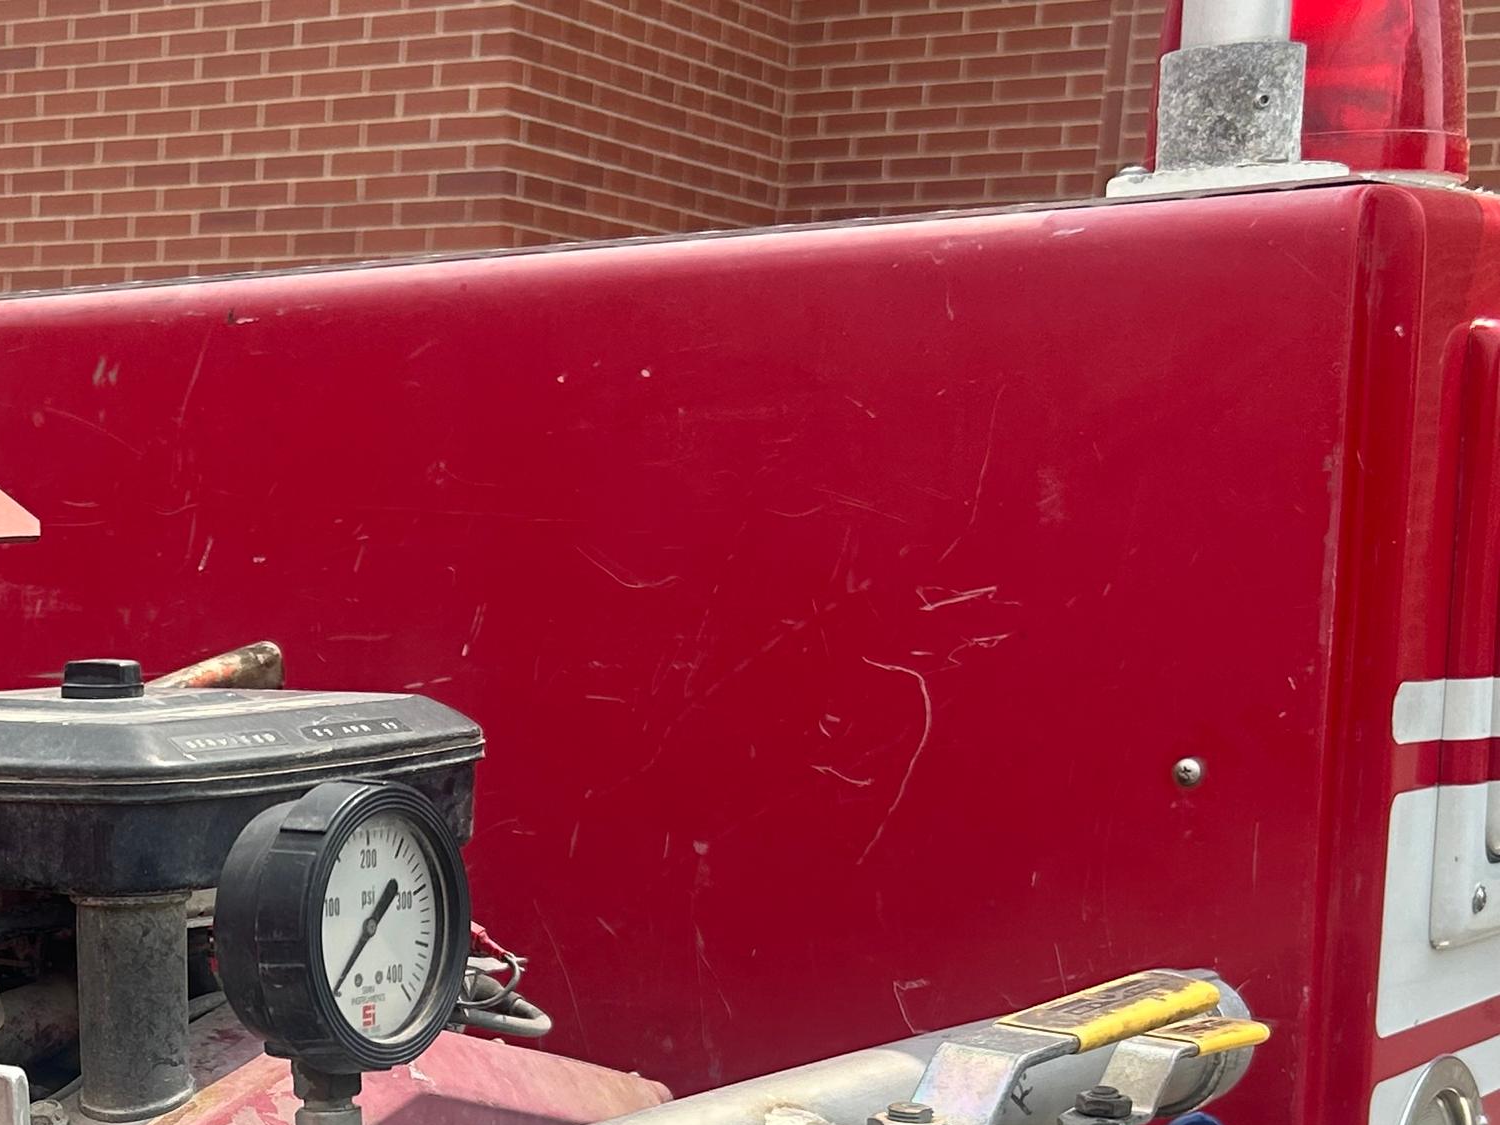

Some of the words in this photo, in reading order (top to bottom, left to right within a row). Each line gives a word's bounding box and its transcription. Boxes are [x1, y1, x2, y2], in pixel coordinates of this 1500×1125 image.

[360, 848, 377, 869] 200
[361, 885, 376, 910] psi
[395, 890, 413, 911] 300
[386, 963, 403, 984] 400
